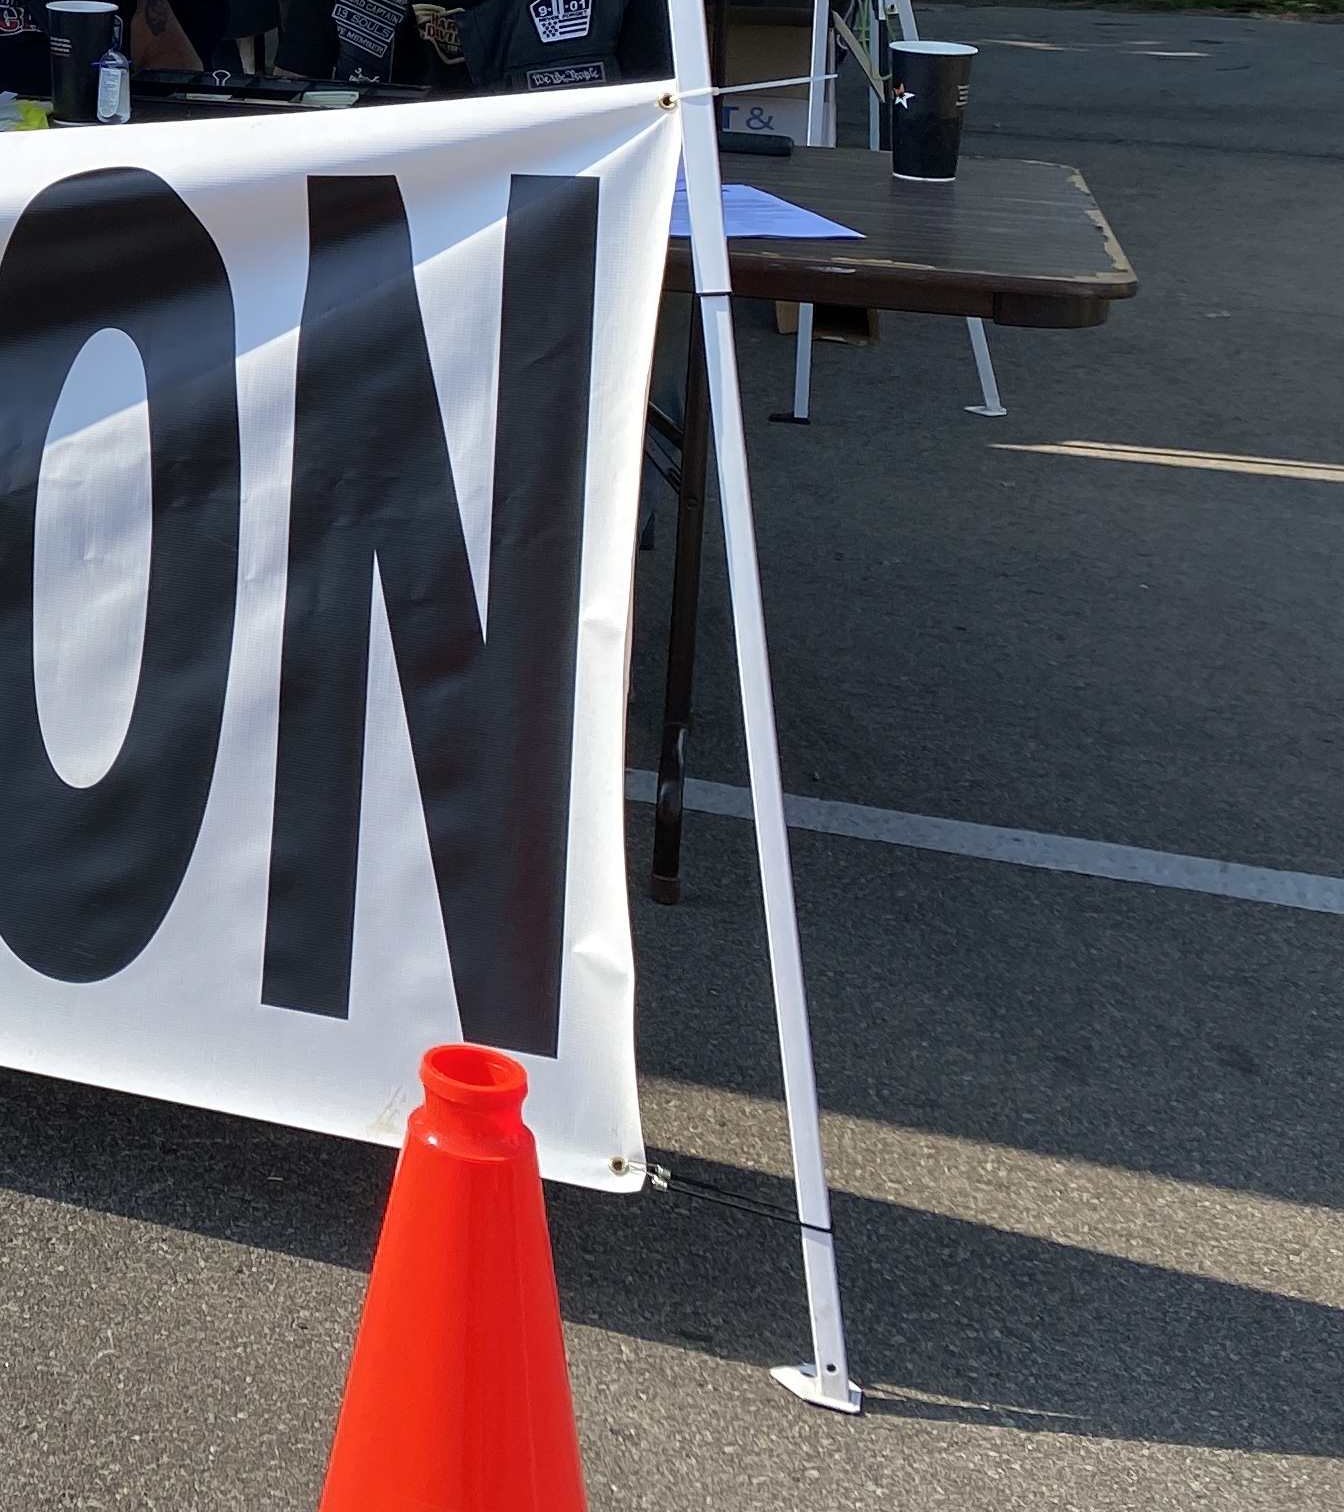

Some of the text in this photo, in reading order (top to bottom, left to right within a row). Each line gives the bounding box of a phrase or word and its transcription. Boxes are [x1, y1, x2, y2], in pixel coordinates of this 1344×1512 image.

[337, 7, 391, 38] 13 SOULS
[366, 3, 399, 24] CAPTAIN
[746, 107, 775, 131] &
